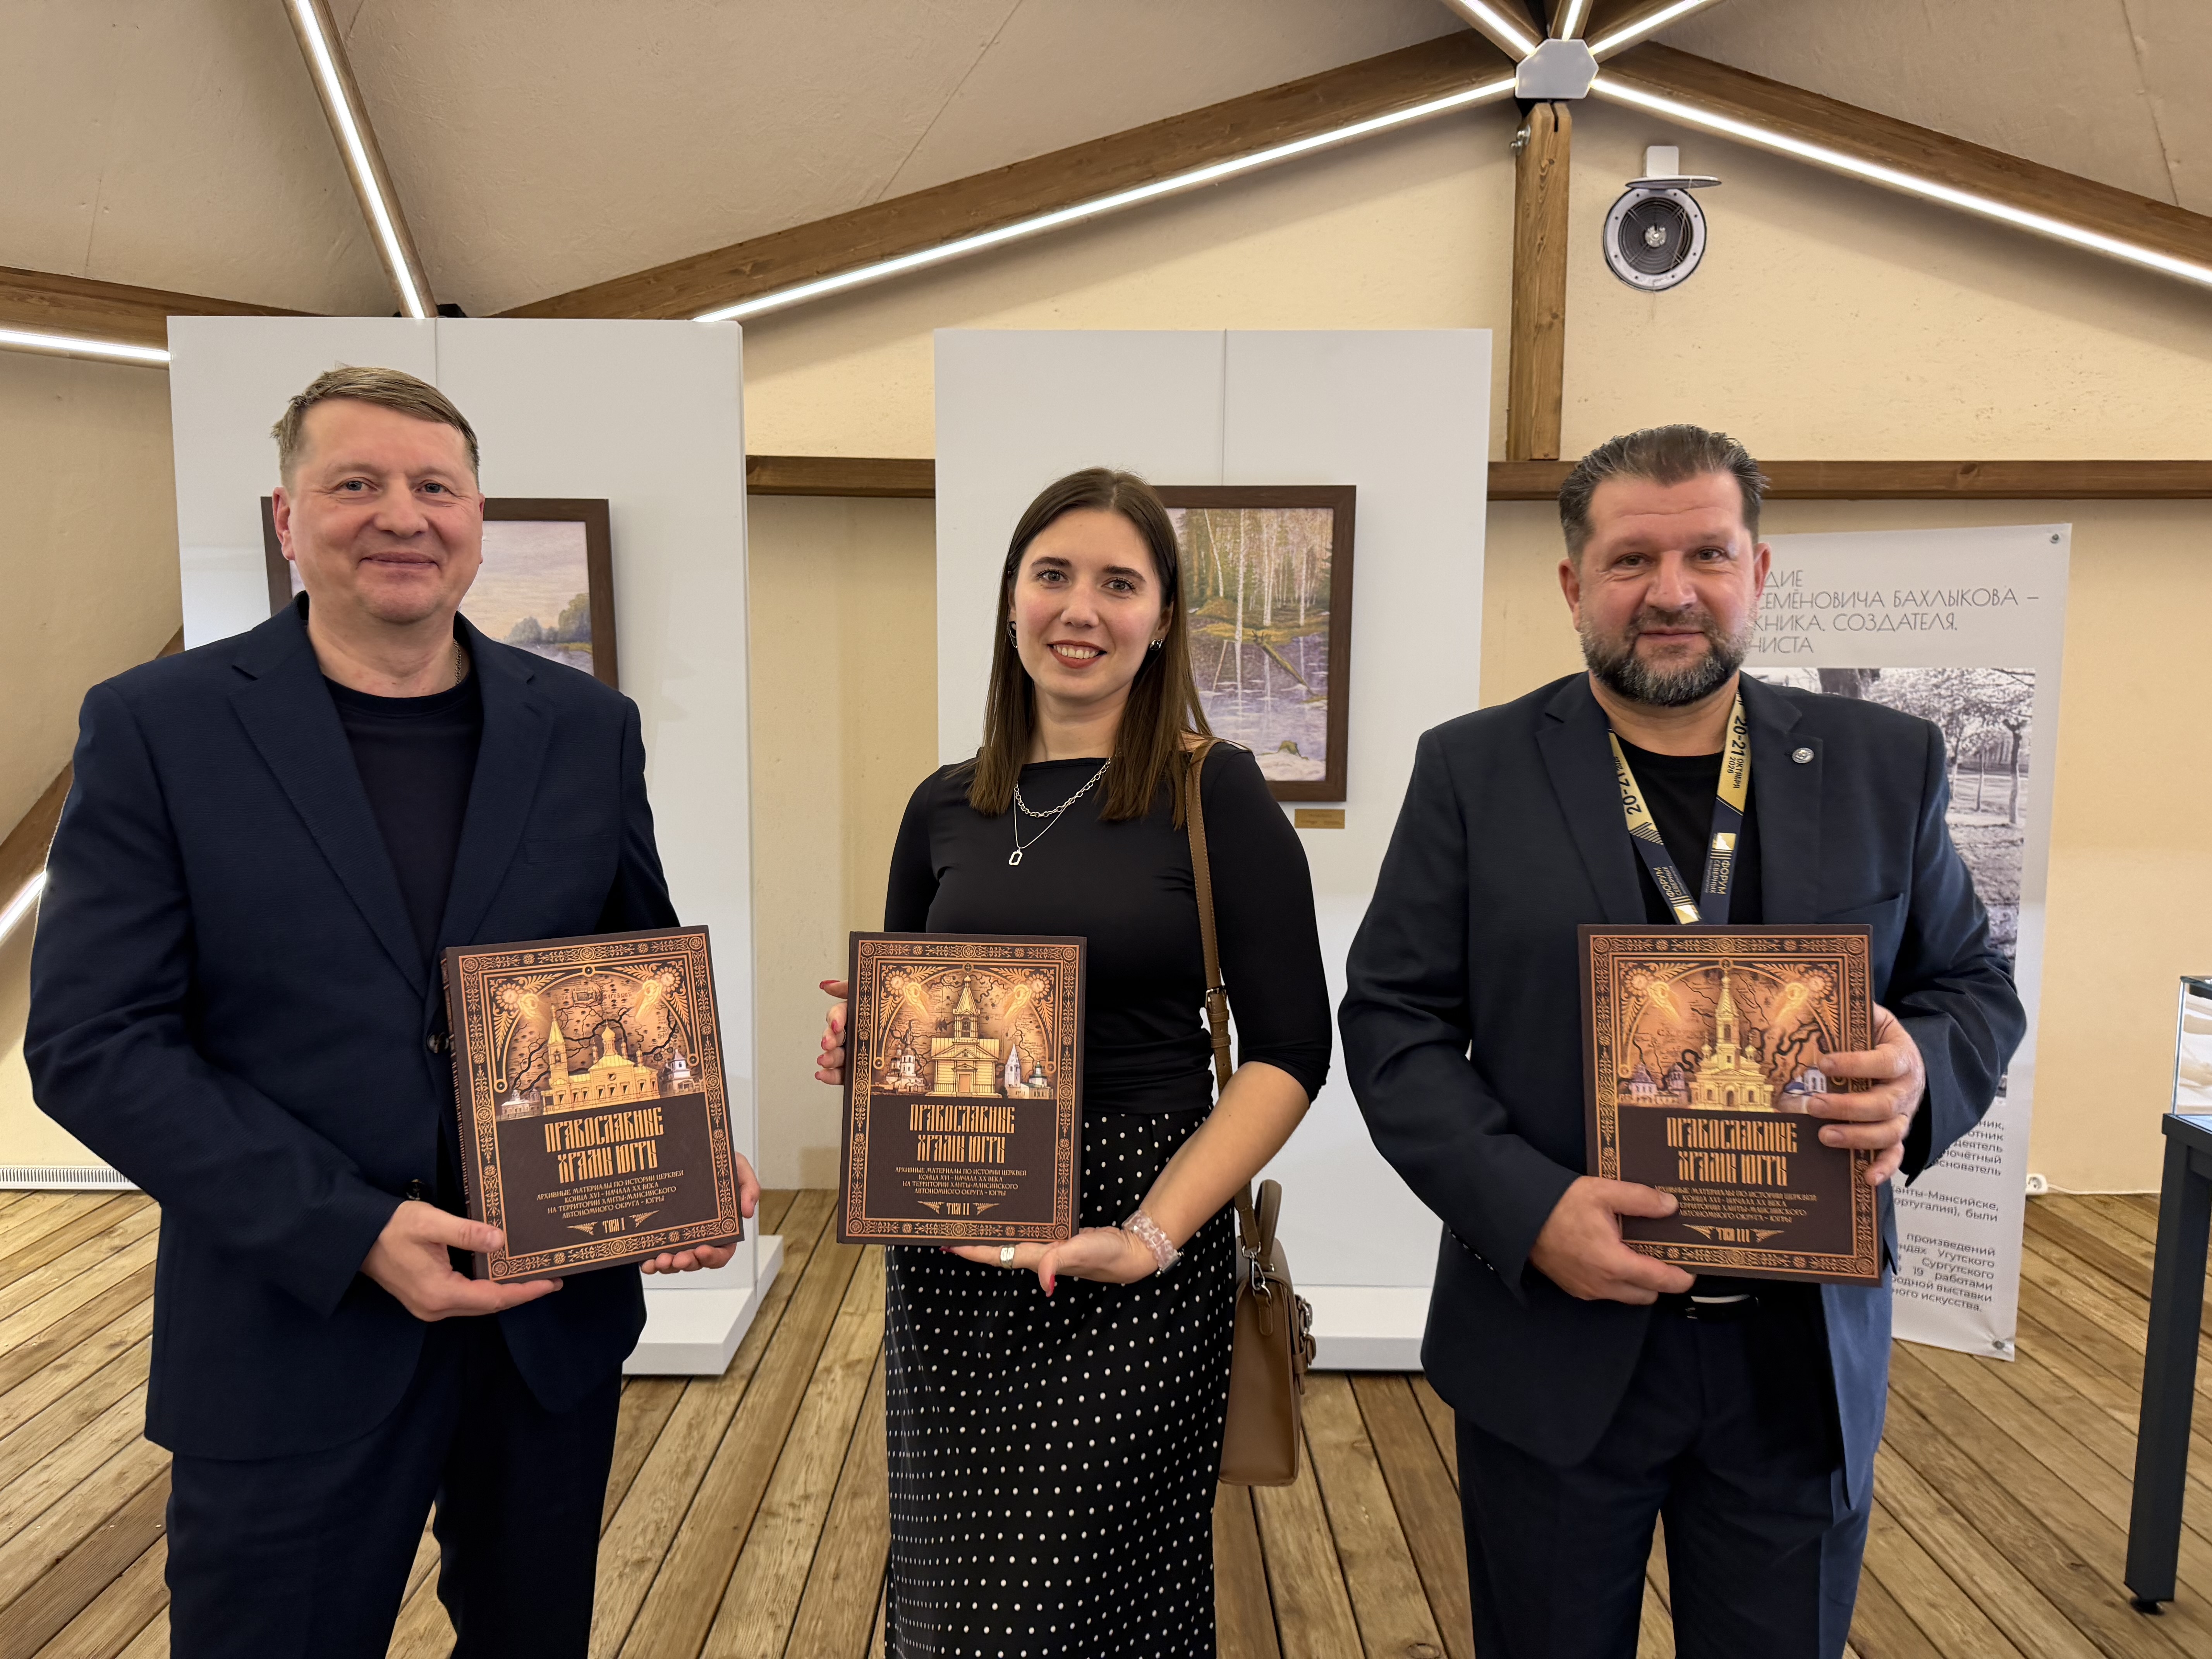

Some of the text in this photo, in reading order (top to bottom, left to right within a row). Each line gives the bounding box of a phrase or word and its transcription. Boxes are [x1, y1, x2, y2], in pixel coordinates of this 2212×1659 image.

[1894, 588, 2018, 608] БАХЛЫКОВА
[1732, 715, 1747, 756] 20-21
[1719, 860, 1731, 895] ФОРУМ
[544, 1107, 664, 1153] ПРАВОСЛАВНЫЕ
[910, 1104, 1015, 1133] ПРАВОСЛАВНЫЕ
[1666, 1117, 1798, 1153] ПРАВОСЛАВНЫЕ
[917, 1134, 1005, 1163] ХРАМЫ ЮГРЫ
[557, 1140, 658, 1183] ХРАМЫ ЮГРЫ
[537, 1190, 571, 1201] АРХИВНЫЕ
[572, 1183, 612, 1195] МАТЕРИАЛЫ
[625, 1175, 655, 1186] ИСТОРИИ
[564, 1194, 587, 1204] КОНЦА
[605, 1187, 630, 1196] НАЧАЛА
[642, 1182, 659, 1190] ВЕКА
[558, 1199, 601, 1212] ТЕРРИТОРИИ
[562, 1205, 614, 1219] АВТОНОМНОГО
[616, 1200, 640, 1210] ОКРУГА
[646, 1195, 665, 1205] ЮГРЫ
[946, 1202, 961, 1215] ТОМ
[1966, 1208, 1998, 1221] были
[603, 1219, 620, 1234] ТОМ
[1907, 1233, 1995, 1256] произведений
[1922, 1257, 1994, 1279] Сургутского
[1937, 1248, 1995, 1268] Угутского
[1913, 1266, 1923, 1276] 19
[1935, 1272, 1993, 1291] работами
[1937, 1284, 1992, 1302] выставки
